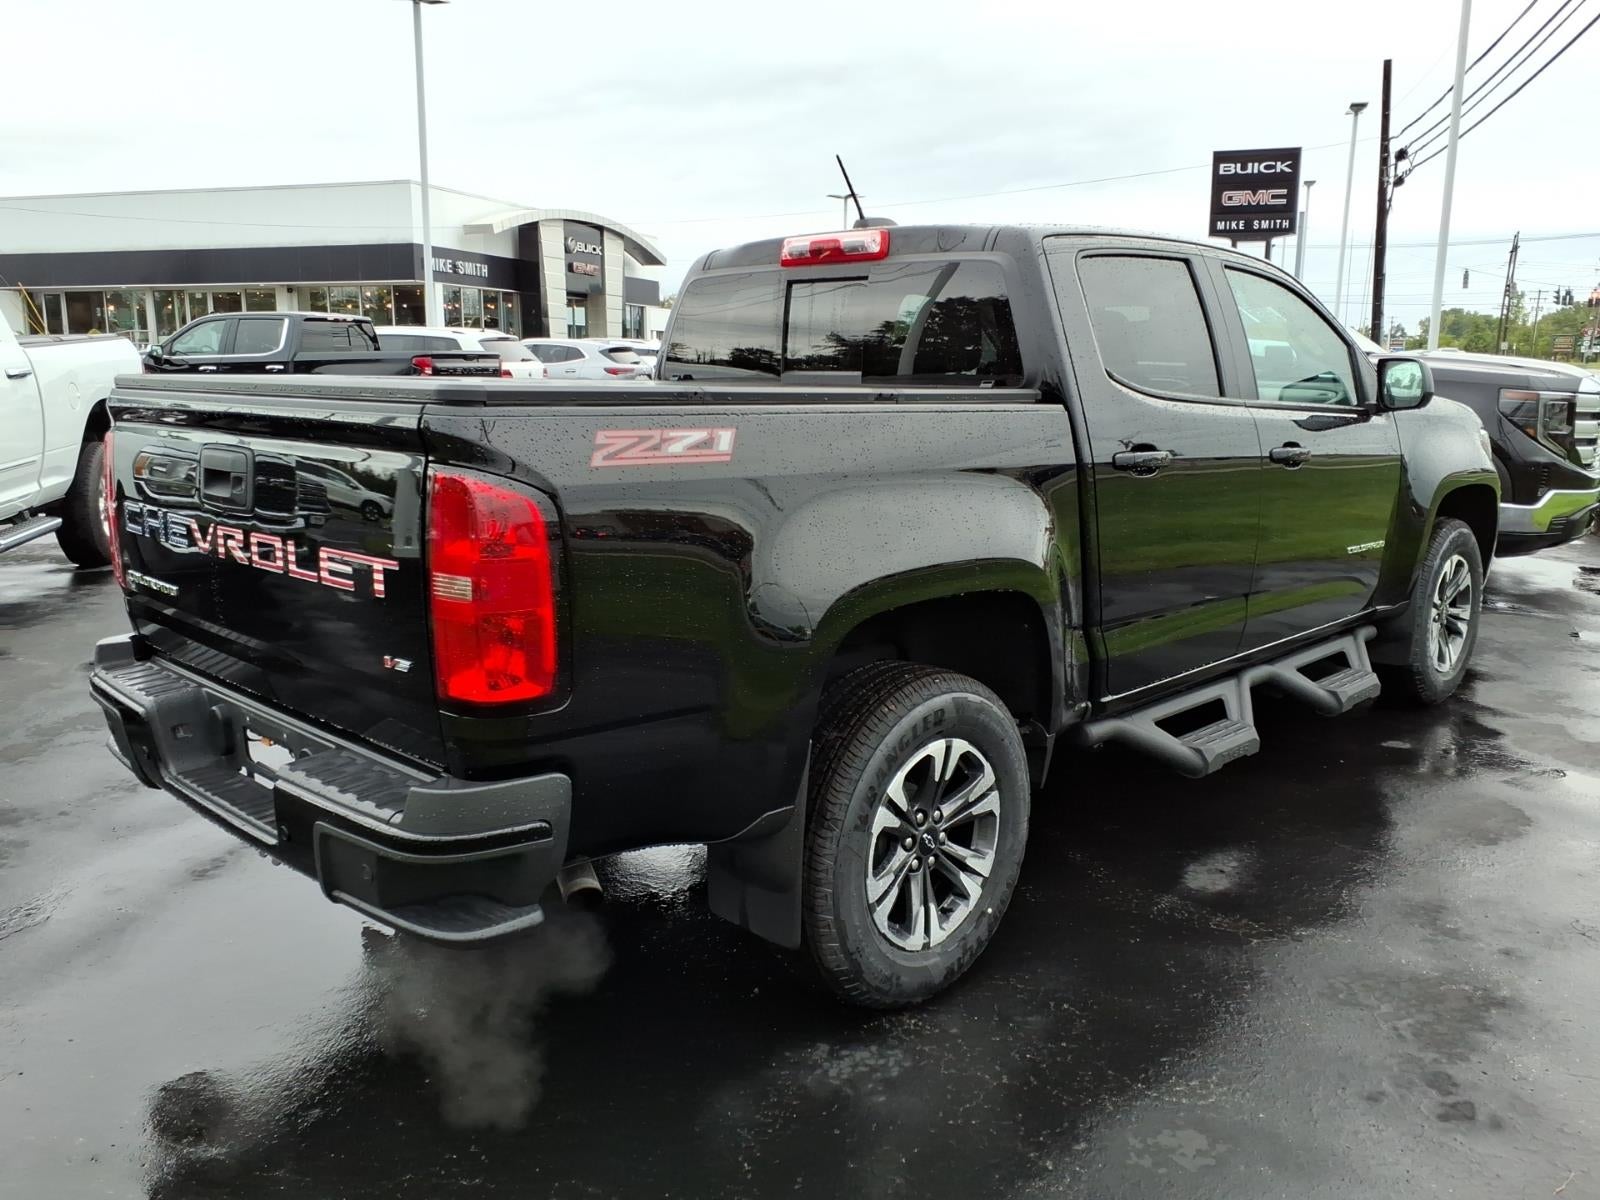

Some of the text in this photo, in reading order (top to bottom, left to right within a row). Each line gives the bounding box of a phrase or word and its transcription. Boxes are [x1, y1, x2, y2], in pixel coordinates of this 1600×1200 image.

[1219, 161, 1293, 174] BUICK
[1222, 189, 1288, 206] GMC
[1217, 219, 1289, 230] MIKE SMITH
[576, 241, 602, 256] BUICK
[458, 260, 488, 278] SMITH
[590, 428, 736, 467] Z71
[124, 500, 399, 598] CHEVROLET
